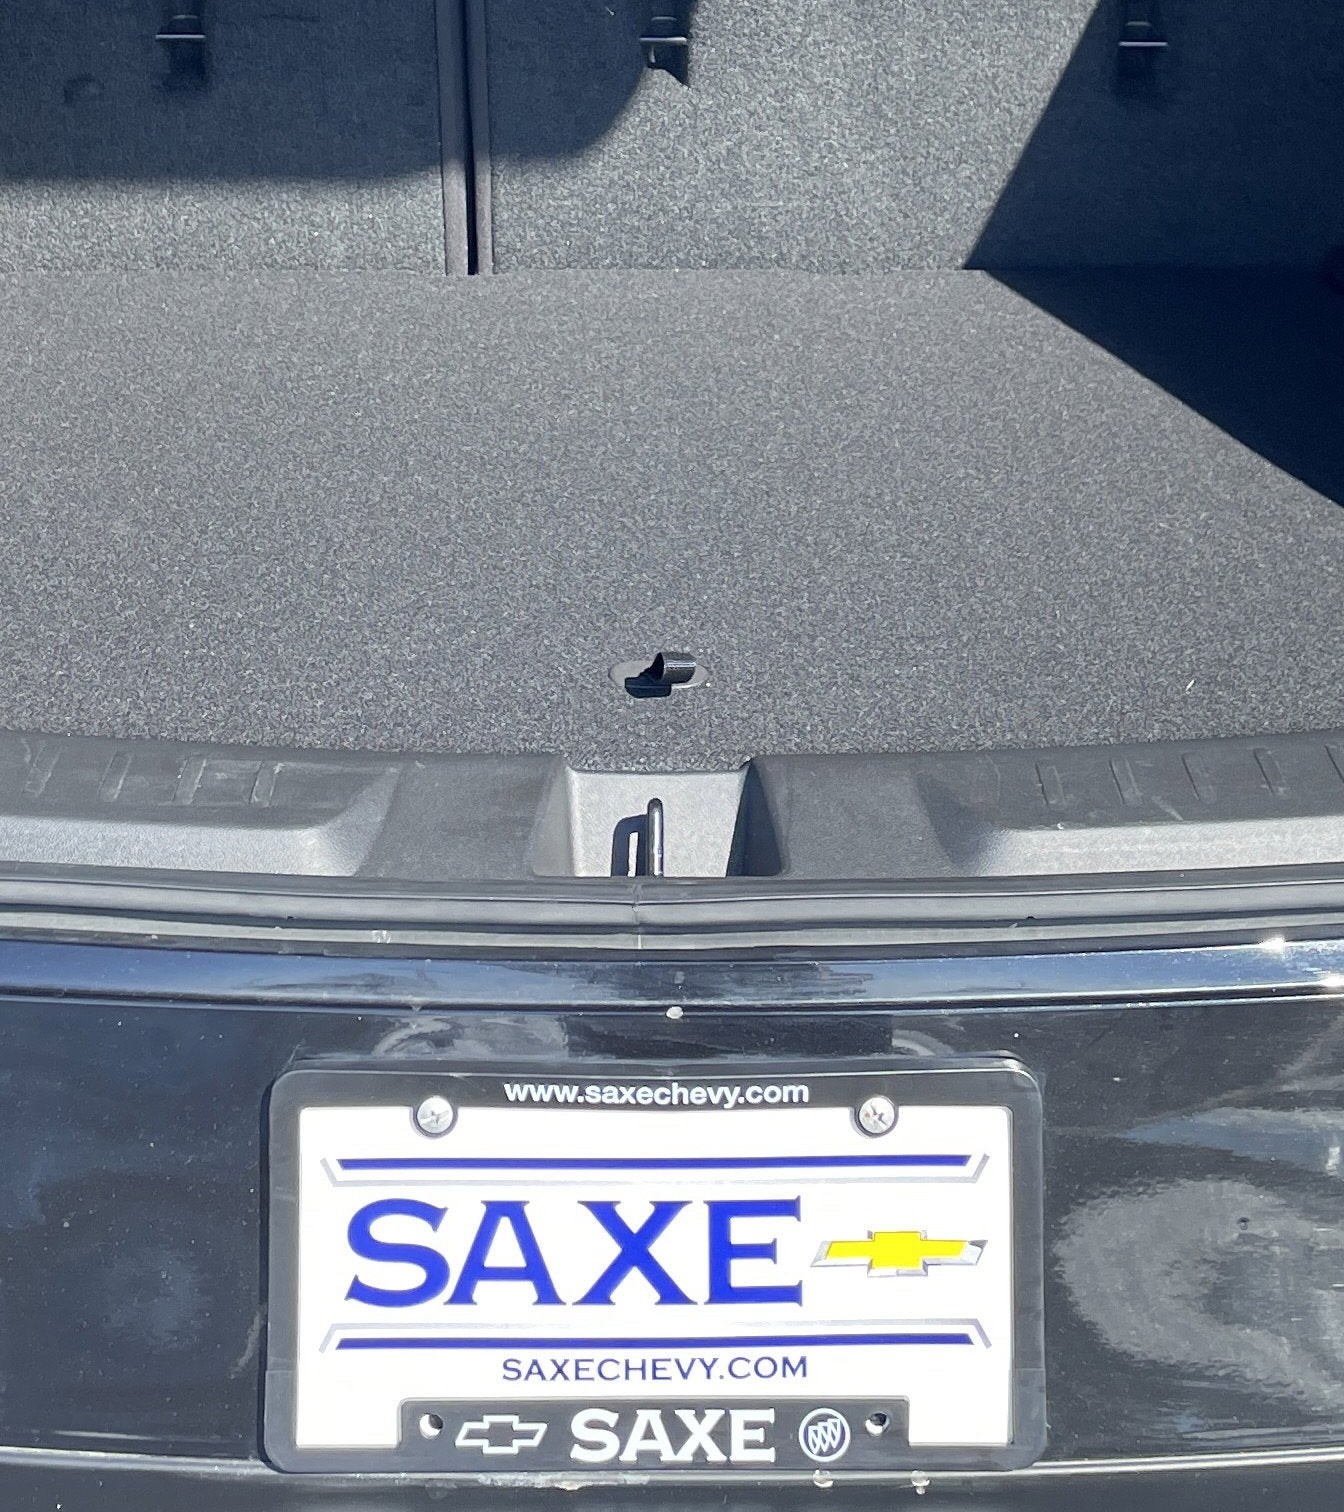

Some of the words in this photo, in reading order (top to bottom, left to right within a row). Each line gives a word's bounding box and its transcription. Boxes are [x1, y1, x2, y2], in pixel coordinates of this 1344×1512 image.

[503, 1082, 810, 1109] www.saxechevy.com
[344, 1195, 804, 1308] SAXE
[502, 1355, 808, 1381] SAXECHEVY.COM
[569, 1407, 776, 1463] SAXE
